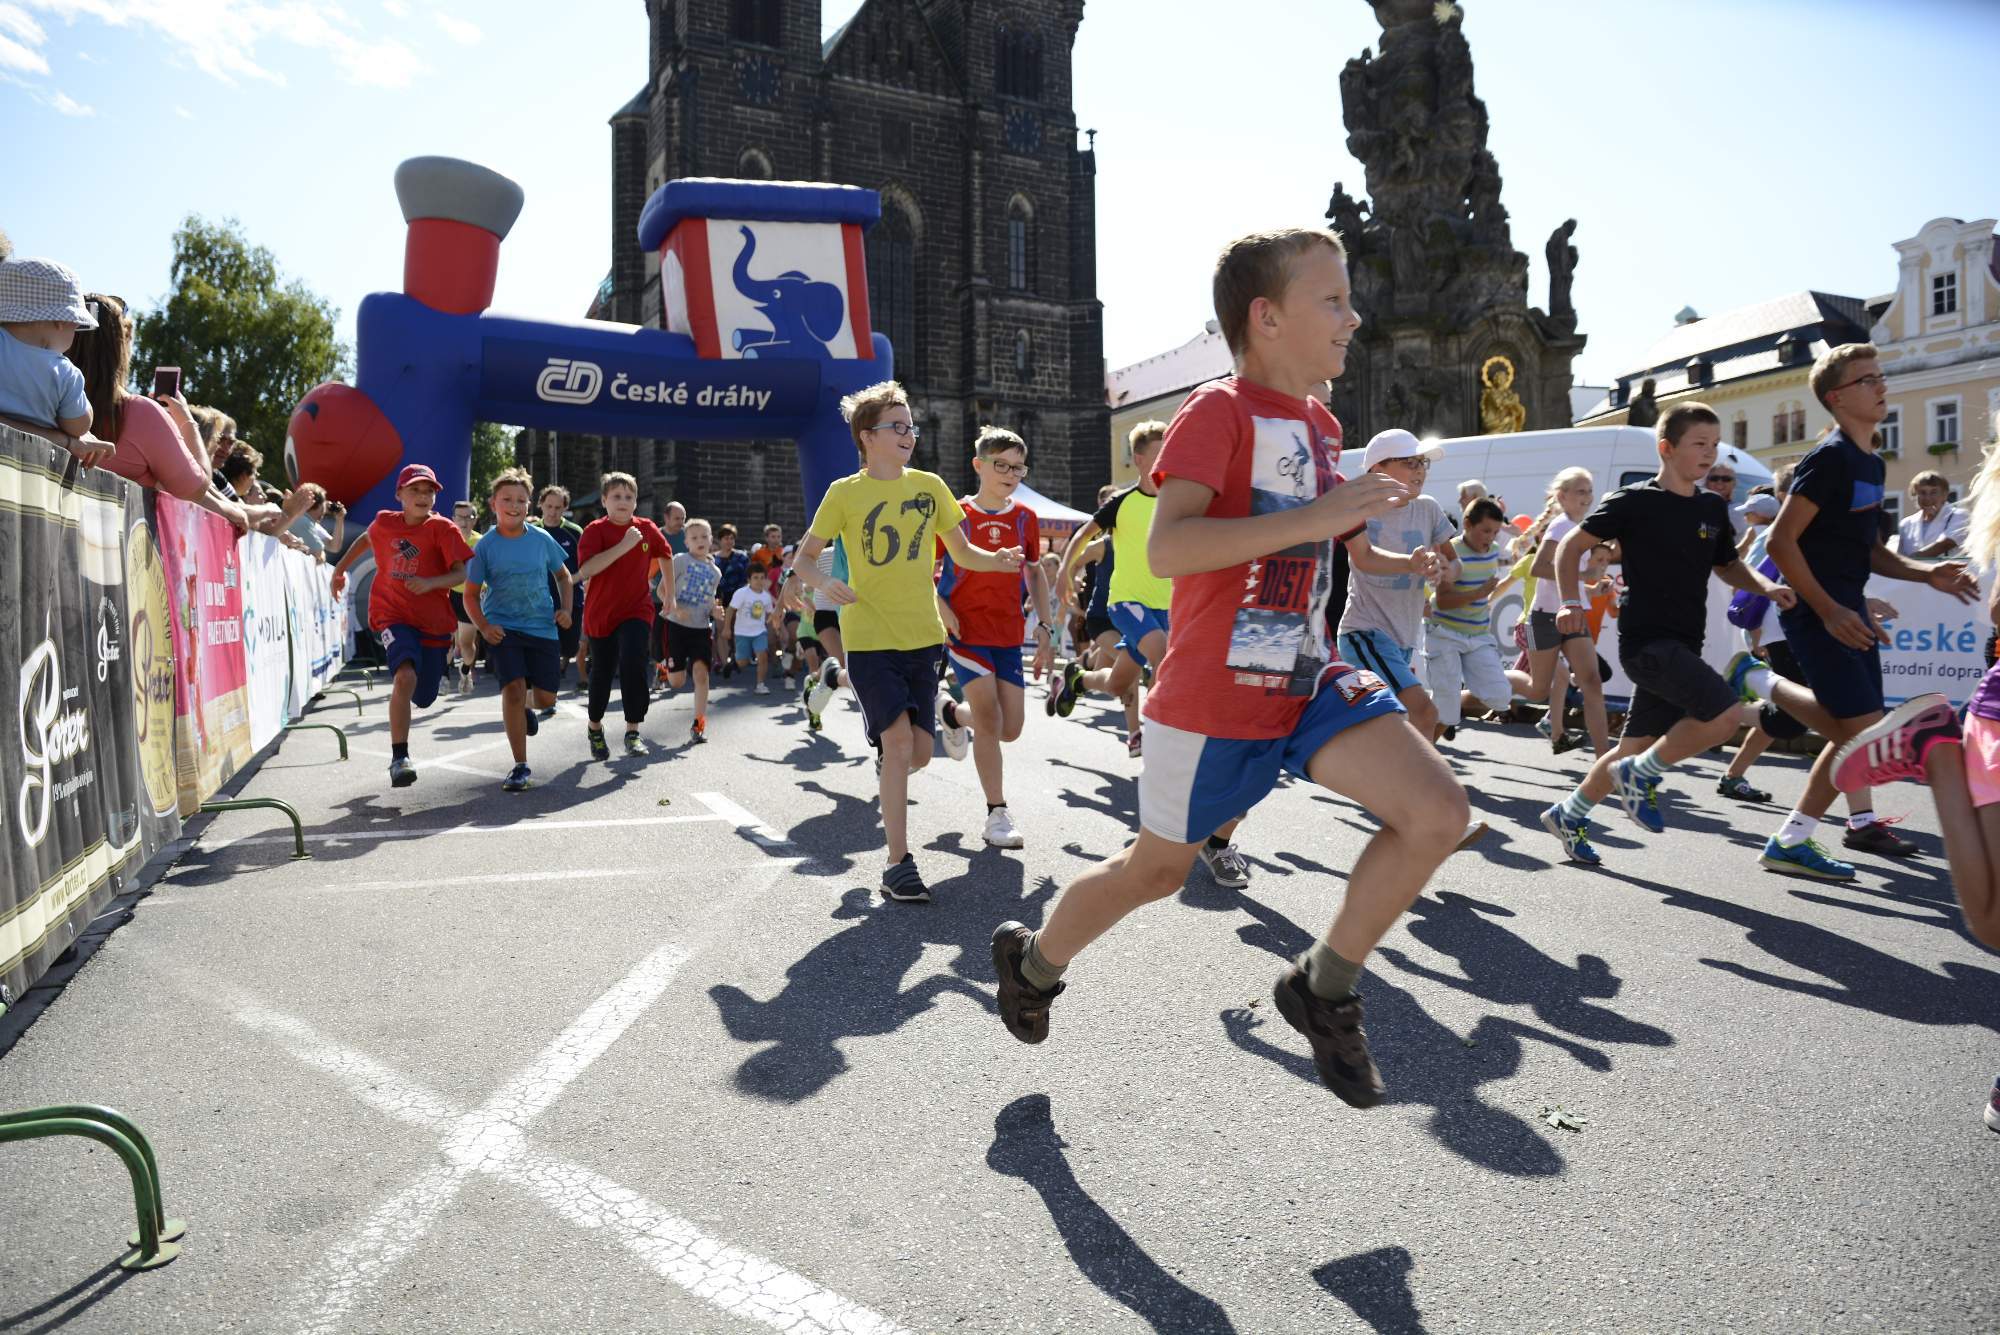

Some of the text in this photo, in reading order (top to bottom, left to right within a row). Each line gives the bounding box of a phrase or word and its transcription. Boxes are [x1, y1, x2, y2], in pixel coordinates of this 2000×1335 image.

[610, 372, 772, 411] České dráhy
[861, 492, 936, 566] 67
[1258, 560, 1311, 608] DIST.
[1881, 660, 1934, 676] árodní
